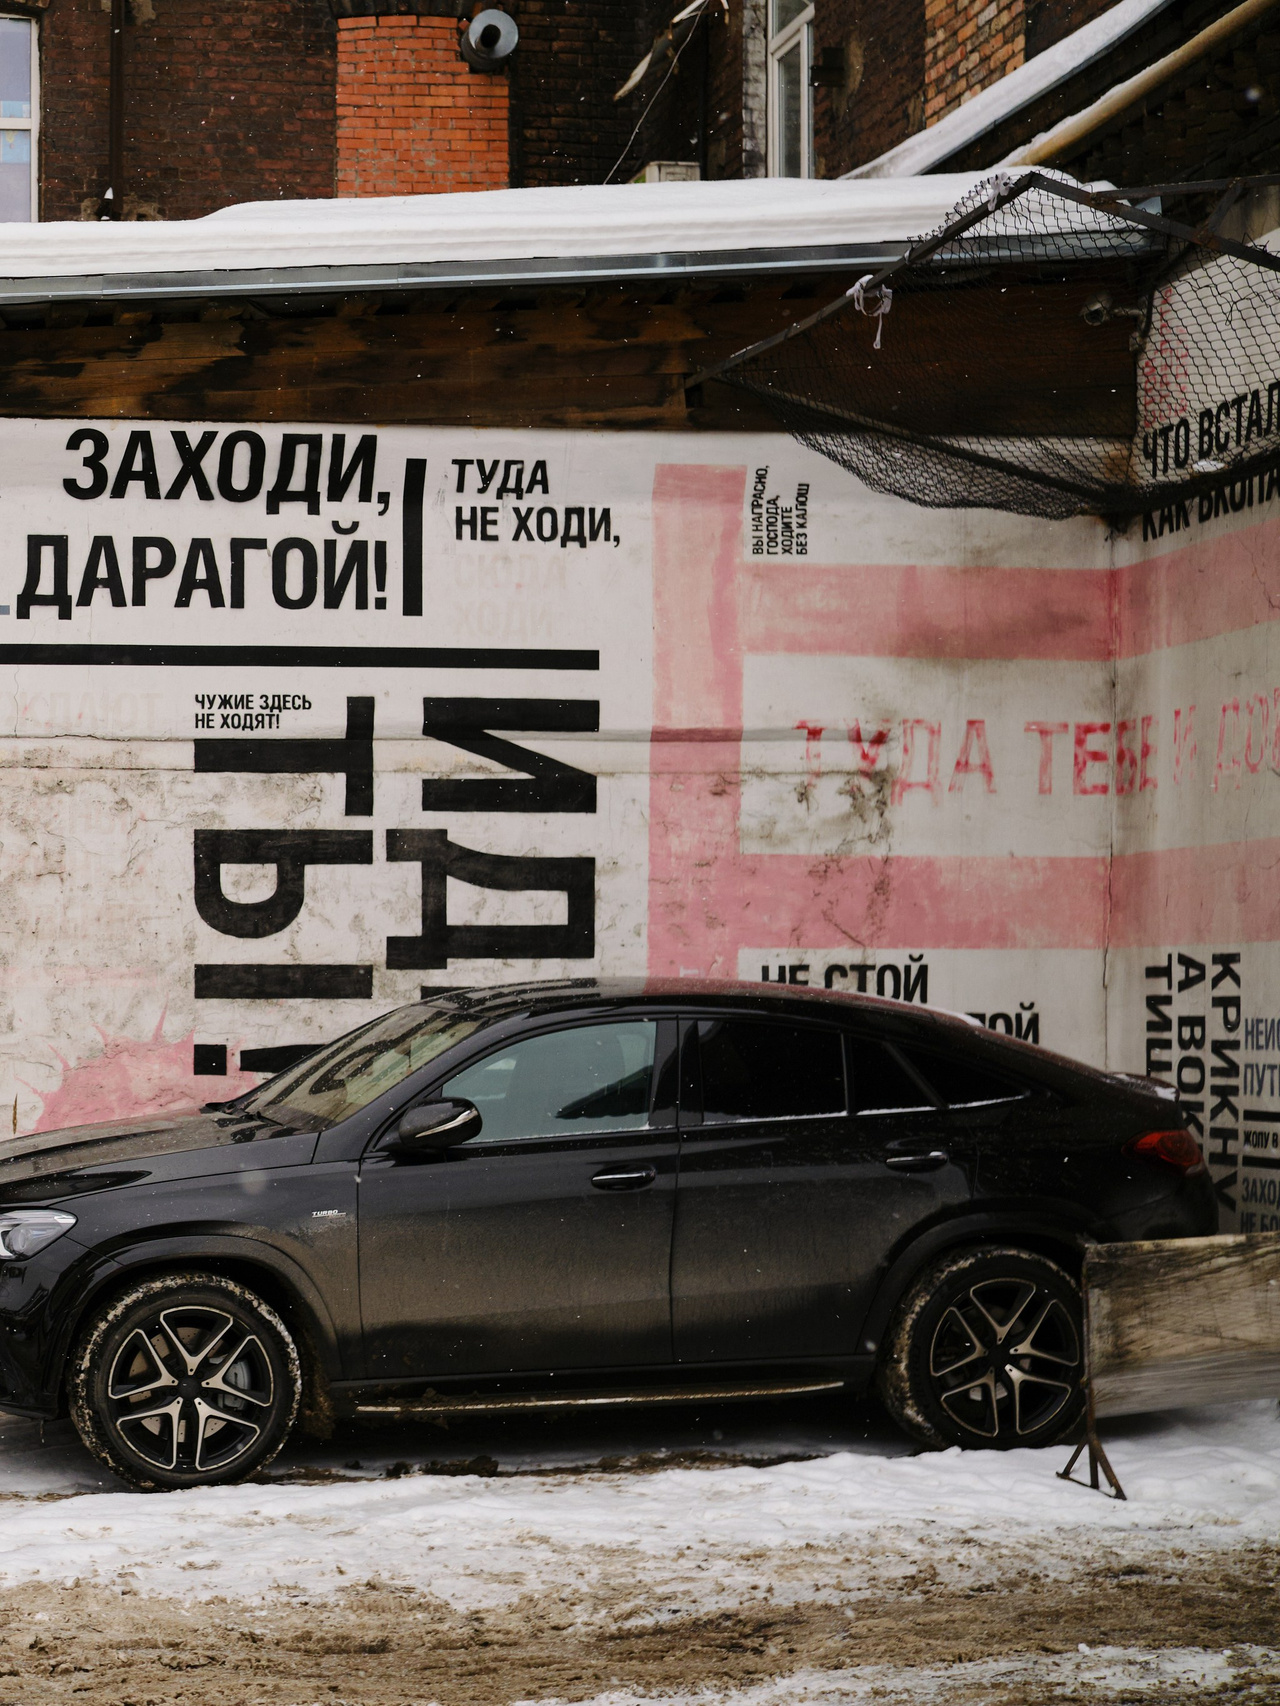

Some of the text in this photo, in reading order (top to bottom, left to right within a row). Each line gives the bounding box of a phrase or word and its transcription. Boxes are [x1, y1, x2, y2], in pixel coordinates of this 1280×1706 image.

[62, 428, 391, 518] ЗАХОДИ,
[1143, 418, 1190, 478] ЧТО
[452, 459, 549, 500] ТУДА
[455, 506, 621, 548] НЕ ХОДИ,
[751, 465, 770, 555] ВЫ НАПРАСНО,
[766, 495, 780, 555] ГОСПОДА,
[781, 506, 794, 555] ХОДИТЕ
[795, 483, 810, 555] БЕЗ КАЛОШ
[16, 520, 388, 620] ДАРАГОЙ!
[195, 694, 313, 712] ЧУЖИЕ ЗДЕСЬ
[195, 713, 280, 731] НЕ ХОДЯТ!
[793, 718, 997, 806] ТУДА
[1024, 715, 1159, 796] ТЕБЕ
[386, 697, 600, 1000] ИД
[824, 954, 928, 1004] СТОЙ
[1177, 953, 1206, 1152] А ВОК
[1243, 1063, 1280, 1097] ПУТ
[1208, 953, 1241, 1213] КРИКНУ
[312, 1209, 338, 1217] TURBO
[1241, 1176, 1280, 1211] ЗАХО
